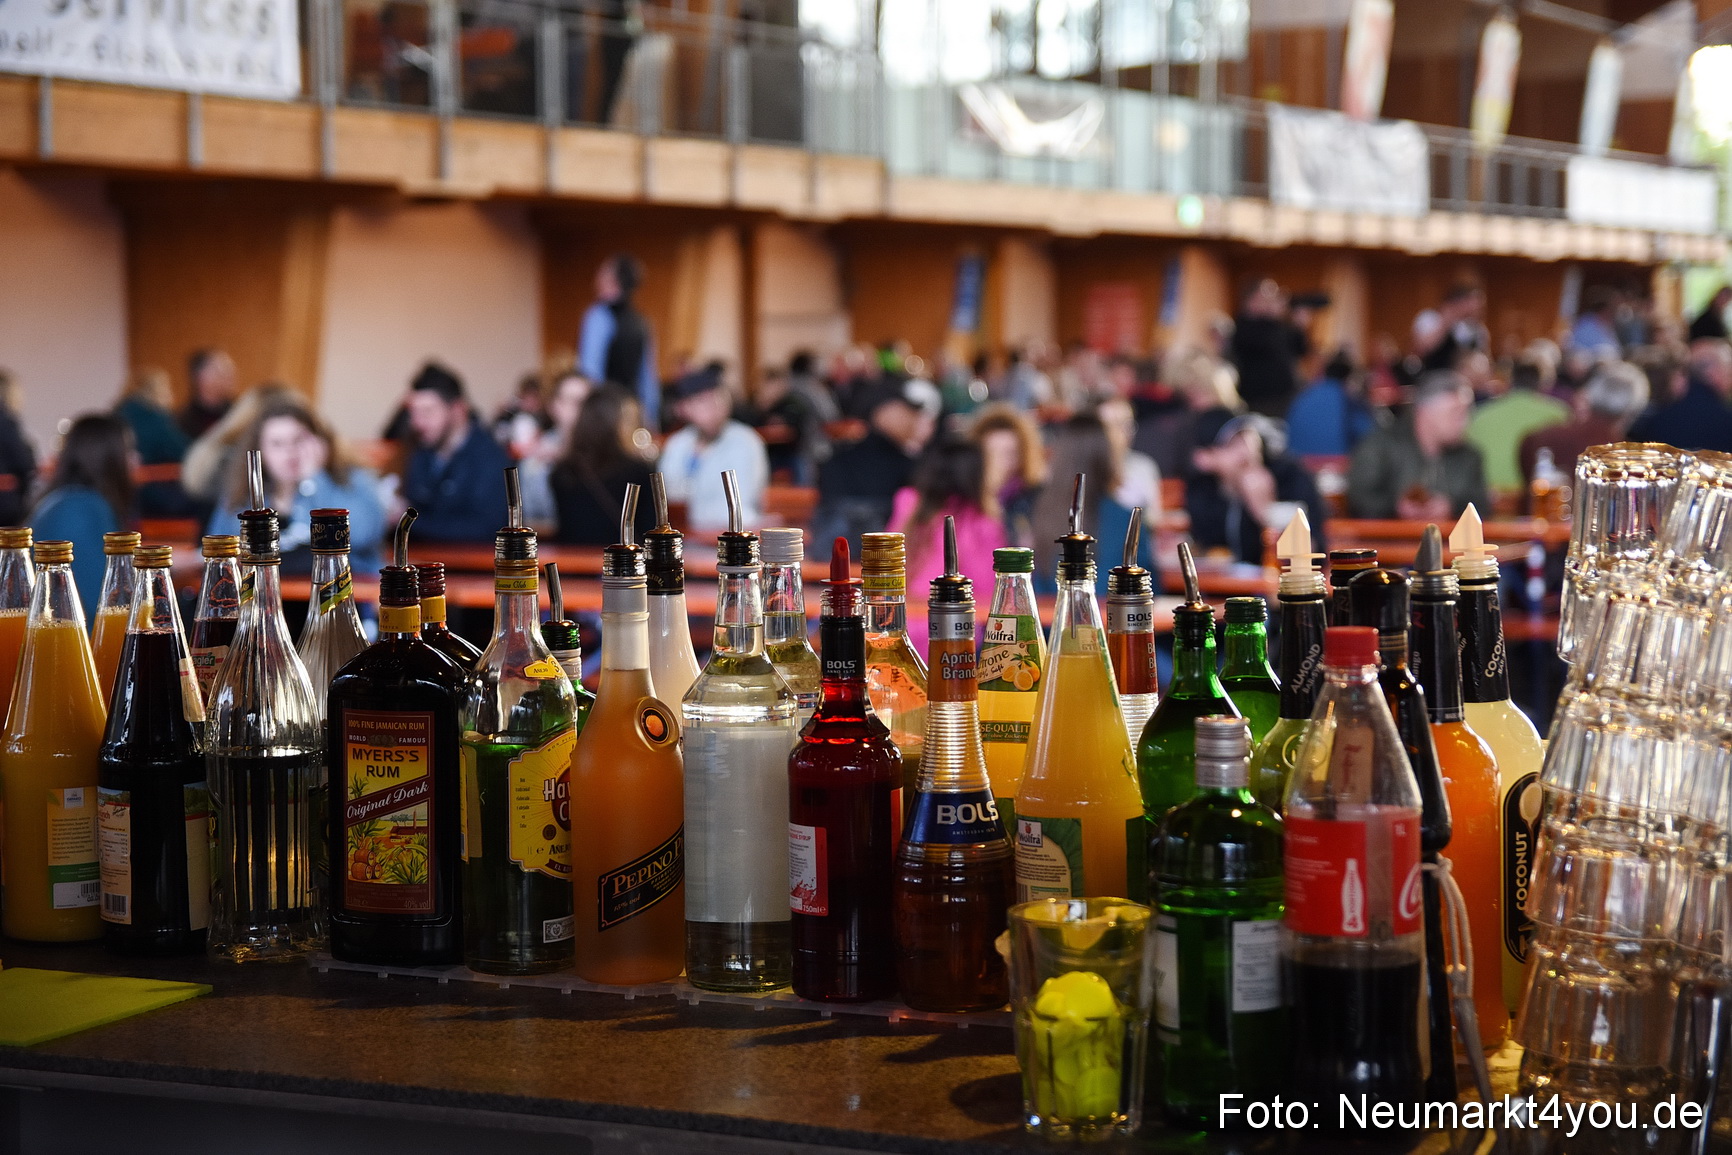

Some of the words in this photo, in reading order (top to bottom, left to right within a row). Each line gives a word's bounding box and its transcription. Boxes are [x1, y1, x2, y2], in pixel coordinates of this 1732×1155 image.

[1127, 613, 1152, 623] BOLS
[827, 660, 855, 669] BOLS
[1290, 643, 1321, 695] ALMOND
[348, 720, 361, 728] 100%
[361, 721, 375, 730] FINE
[375, 721, 408, 731] JAMAICAN
[409, 722, 426, 731] RUM
[348, 734, 366, 742] WORLD
[398, 736, 426, 744] FAMOUS
[365, 765, 401, 778] RUM
[346, 792, 392, 820] Original
[392, 781, 430, 804] Dark
[936, 801, 1000, 825] BOLS
[612, 850, 673, 895] PEPINO
[1515, 831, 1528, 911] COCONUT
